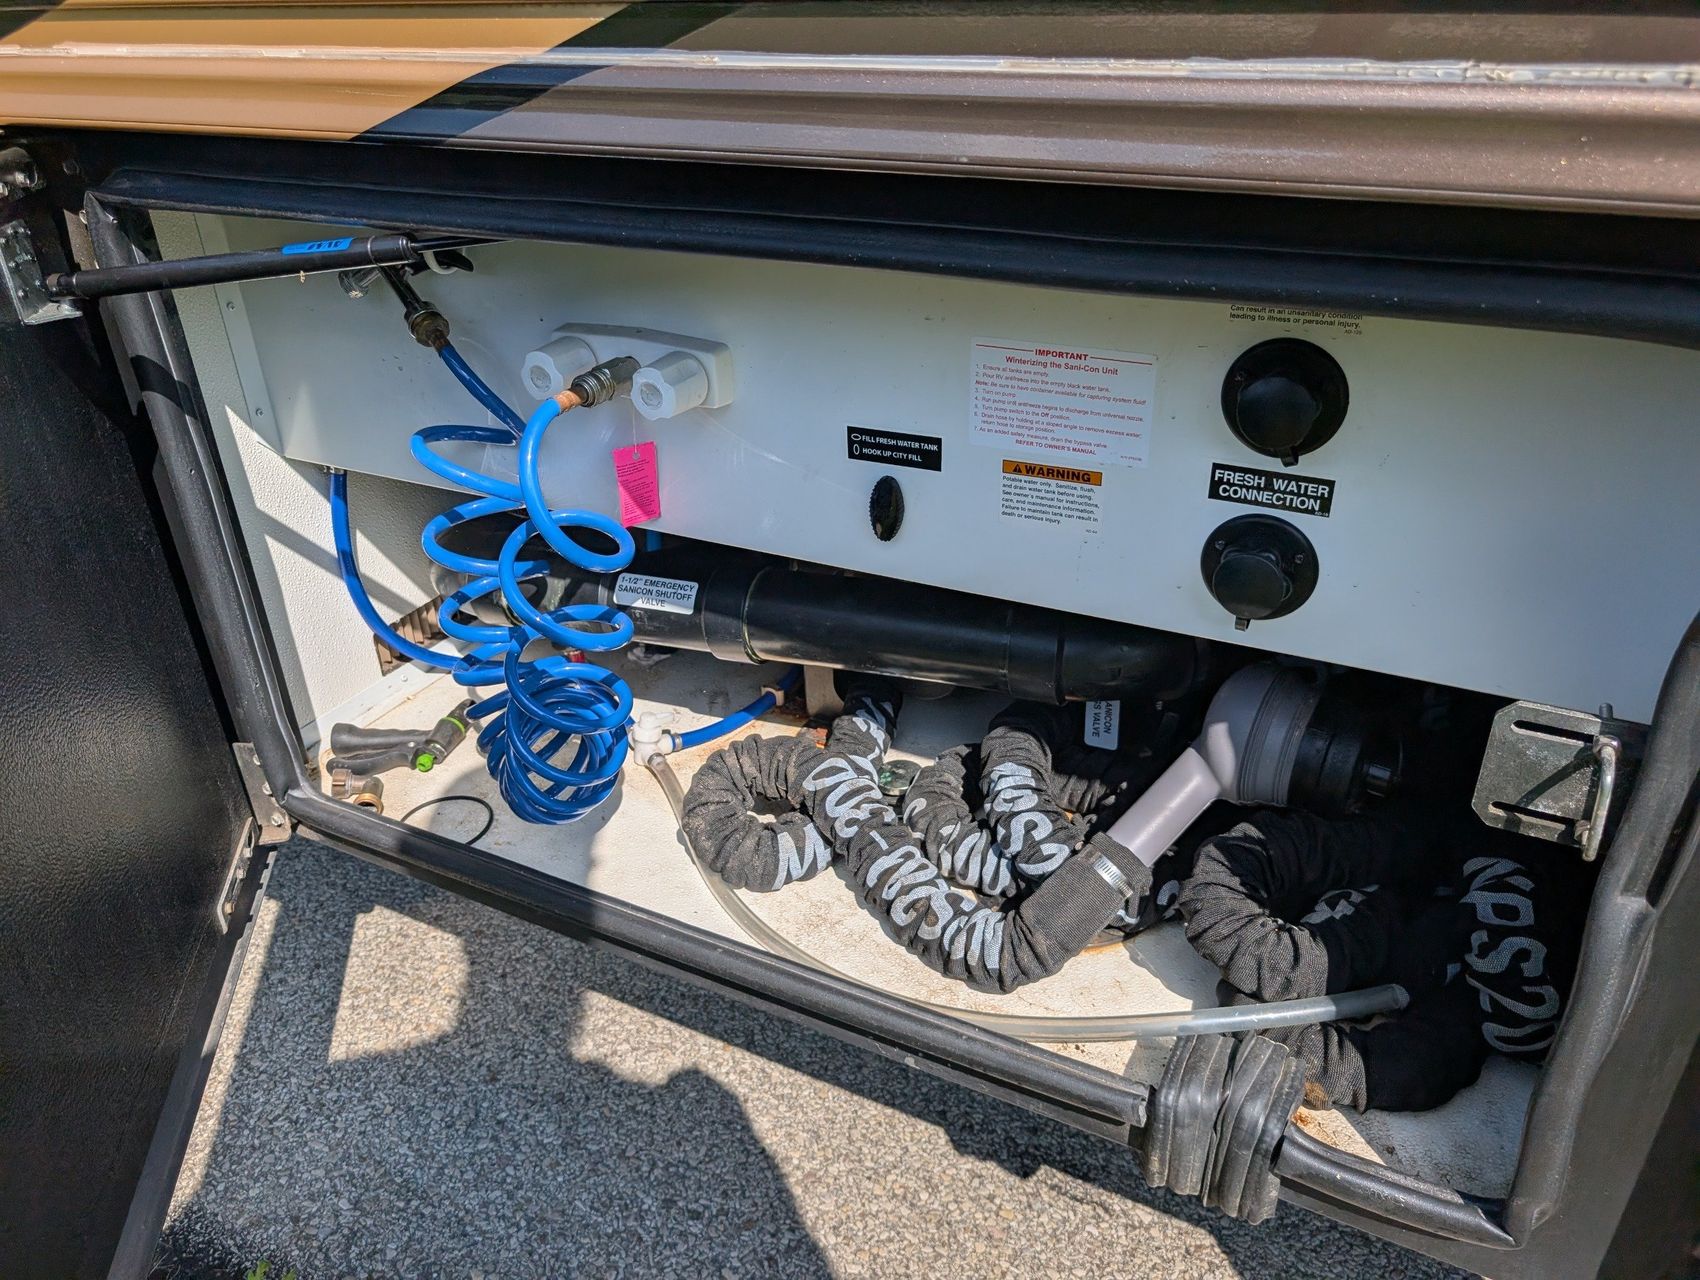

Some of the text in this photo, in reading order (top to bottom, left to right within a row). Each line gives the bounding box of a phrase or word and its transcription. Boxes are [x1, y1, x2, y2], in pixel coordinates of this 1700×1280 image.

[1247, 305, 1266, 313] result
[1287, 309, 1325, 318] unsanitary
[1229, 311, 1255, 321] leading
[1302, 317, 1335, 327] personal
[1337, 320, 1360, 329] injury.
[1034, 349, 1088, 360] IMPORTANT
[1005, 355, 1118, 375] Winterizing the Sani-Con Unit
[1086, 393, 1111, 401] capturing
[1112, 396, 1131, 404] system
[1064, 407, 1089, 415] discharge
[862, 435, 938, 451] FILL FRESH WATER TANK
[862, 448, 882, 456] HOOK
[892, 452, 908, 460] CITY
[908, 454, 922, 462] FILL
[1071, 447, 1096, 455] MANUAL
[1025, 465, 1091, 482] WARNING
[1214, 470, 1329, 497] FRESH WATER
[1065, 498, 1099, 508] instructions,
[1219, 484, 1320, 511] CONNECTION
[1026, 500, 1061, 509] maintenance
[1062, 505, 1096, 514] information.
[622, 576, 695, 592] 1-1/2" EMERGENCY
[618, 584, 692, 601] SANICON SHUTOFF
[640, 596, 666, 608] VALVE
[1092, 712, 1101, 738] VALVE
